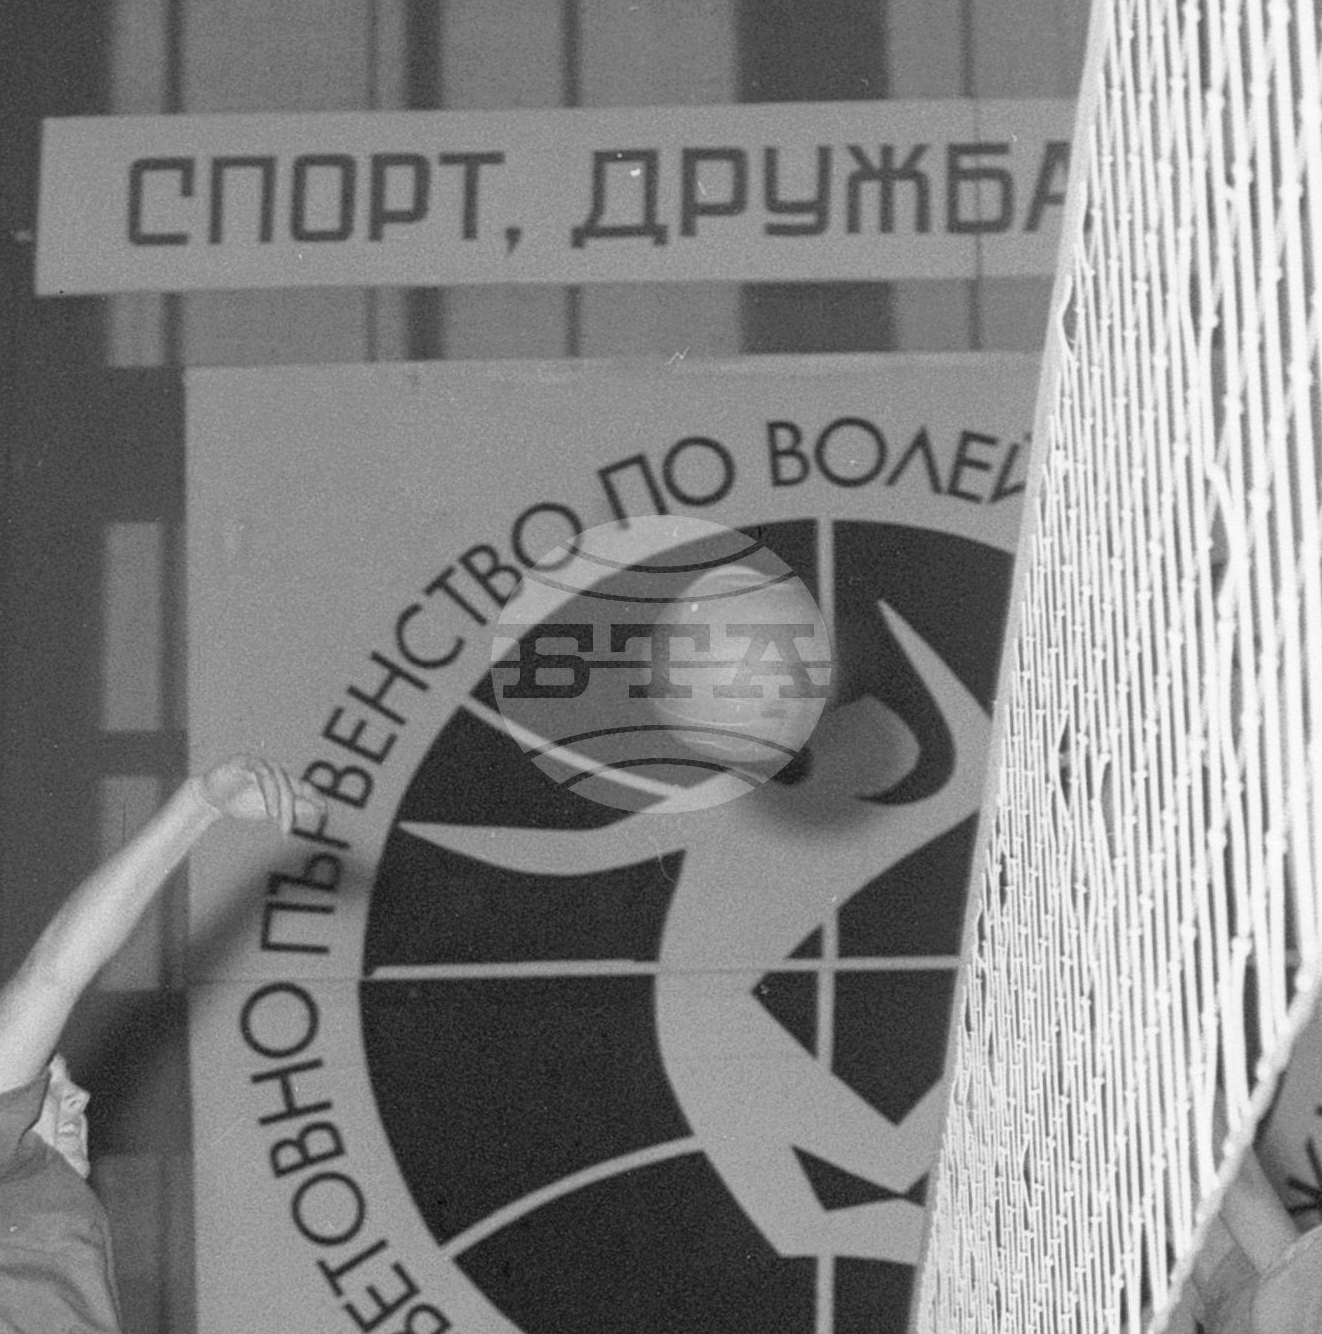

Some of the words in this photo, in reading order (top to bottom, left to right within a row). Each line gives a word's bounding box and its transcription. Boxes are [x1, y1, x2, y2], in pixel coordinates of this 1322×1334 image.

[128, 151, 522, 255] СПОРТ,
[570, 140, 1071, 248] ДРУЖБА
[260, 502, 583, 956] ПЪРВЕНСТВО
[598, 436, 735, 530] ПО
